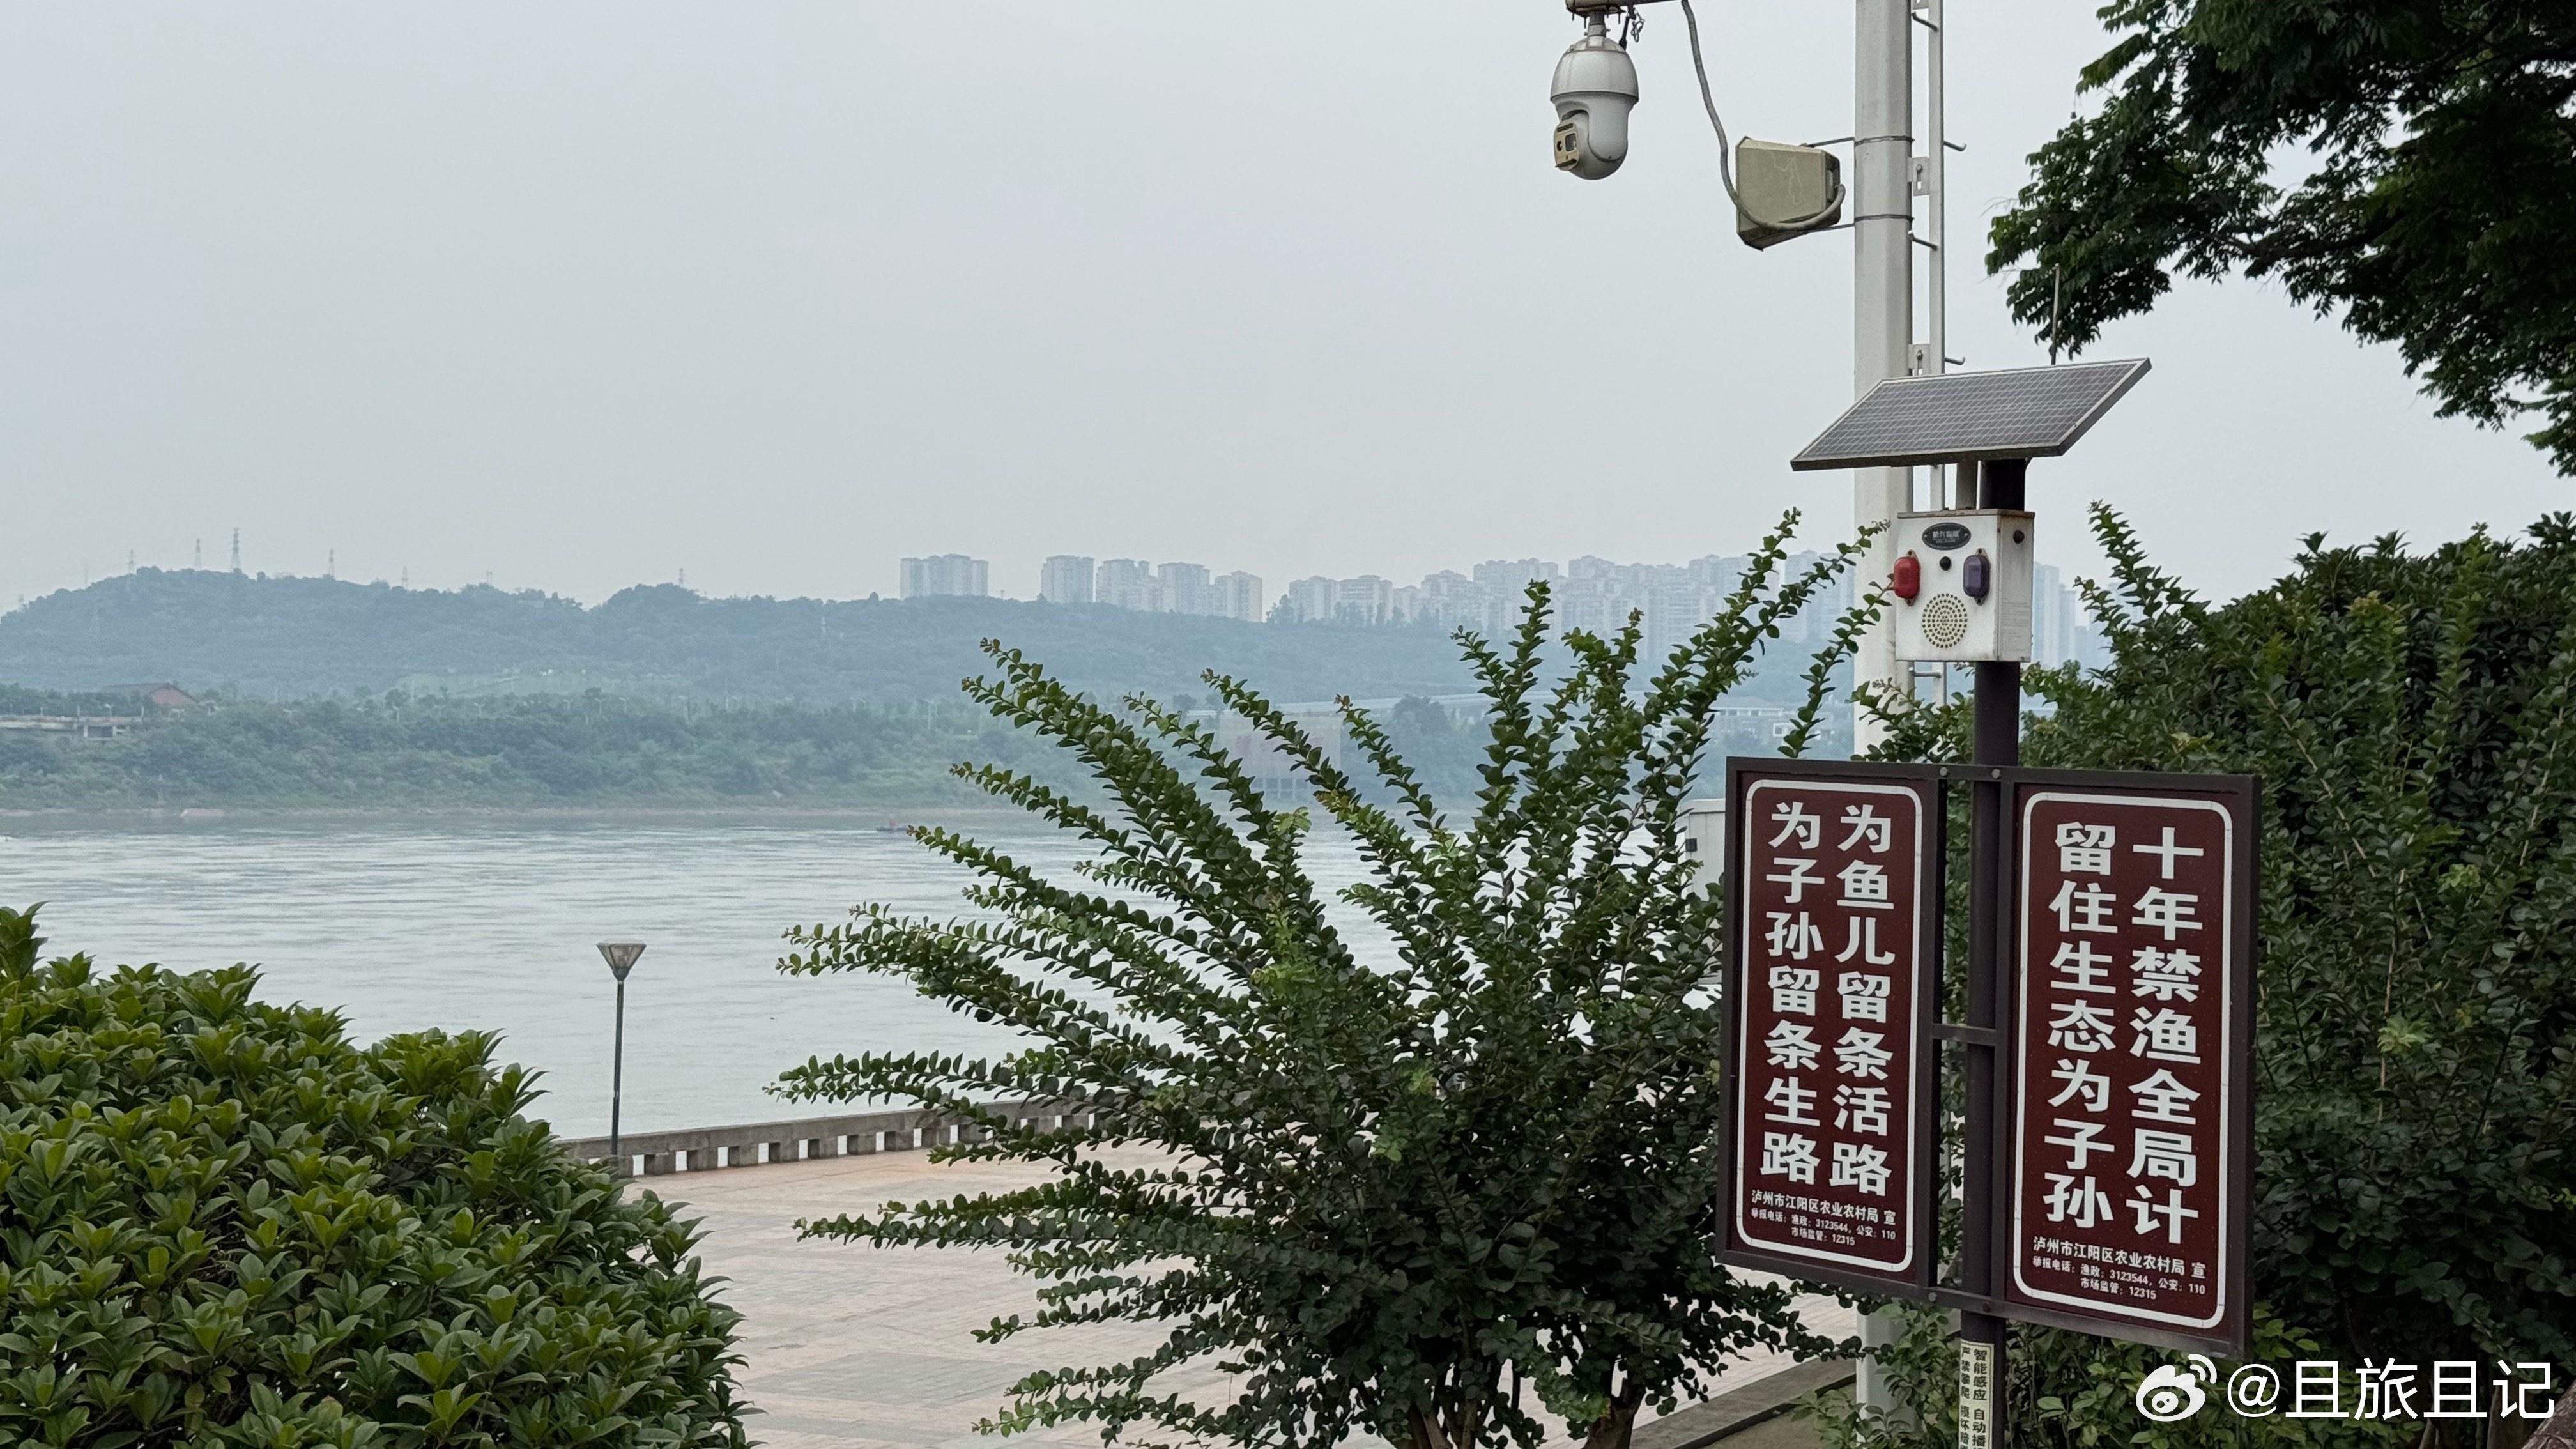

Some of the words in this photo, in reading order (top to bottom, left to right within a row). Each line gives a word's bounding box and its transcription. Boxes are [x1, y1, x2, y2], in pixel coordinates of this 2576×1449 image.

[1760, 802, 1825, 1184] 为子孙留条生路
[1829, 804, 1896, 1197] 为鱼儿留条活路
[2043, 822, 2118, 1228] 留住生态为子孙
[2126, 827, 2204, 1244] 十年禁渔全局计
[1751, 1189, 1879, 1223] 泸州市江阳区农业农村局
[1883, 1209, 1896, 1225] 宣
[2033, 1236, 2185, 1276] 泸州市江阳区农业农村局
[2191, 1262, 2206, 1279] 宣
[1972, 1408, 1986, 1449] 自动播
[1973, 1349, 1988, 1401] 智能感应
